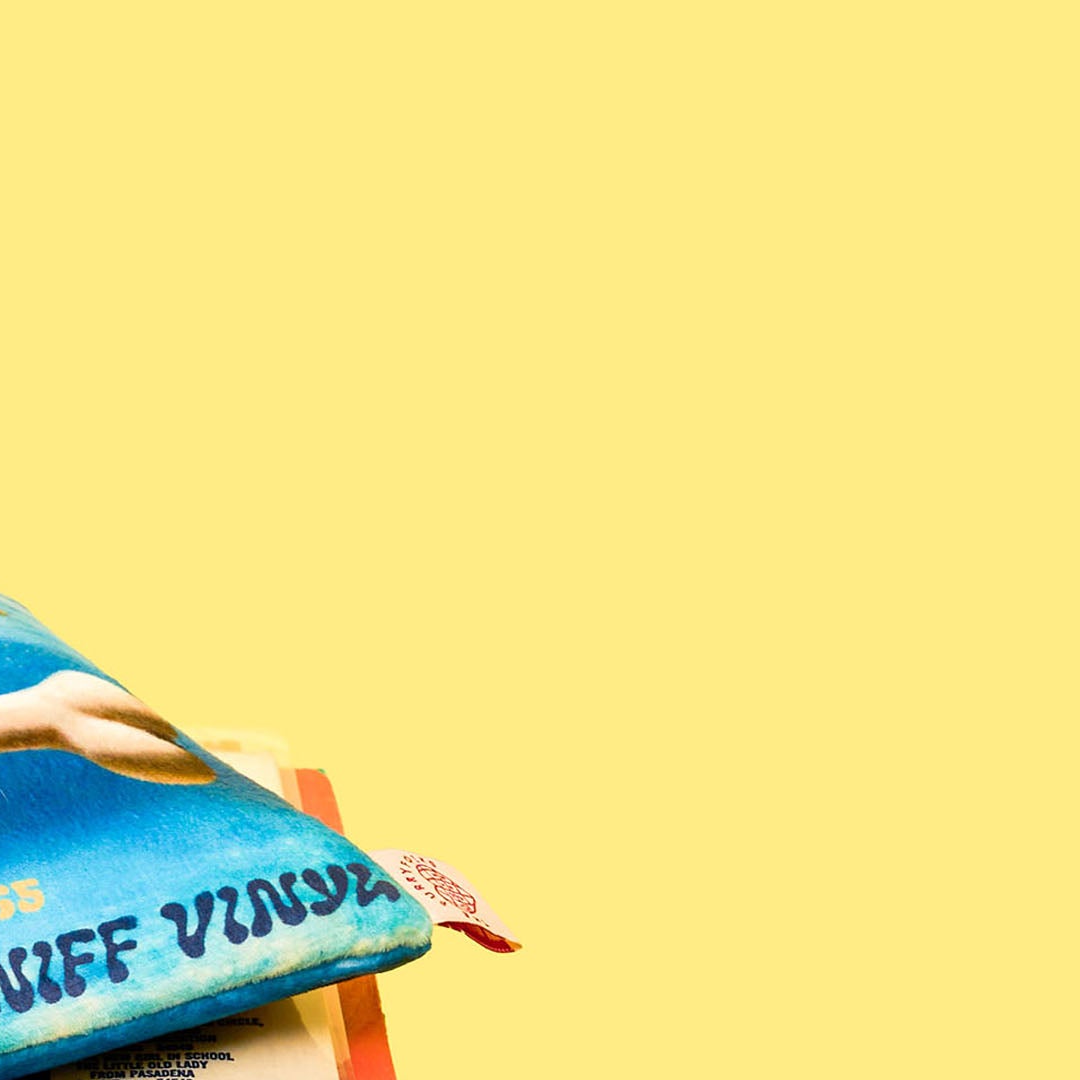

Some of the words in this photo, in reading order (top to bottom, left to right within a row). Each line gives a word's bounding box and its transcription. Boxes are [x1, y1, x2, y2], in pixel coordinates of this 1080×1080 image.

[160, 863, 401, 958] VINYL
[134, 1053, 164, 1061] GIRL
[167, 1053, 181, 1061] IN
[103, 1061, 144, 1070] LITTLE
[147, 1061, 172, 1069] OLD
[176, 1061, 209, 1070] LADY
[90, 1070, 126, 1079] FROM
[130, 1069, 195, 1078] PASADENA
